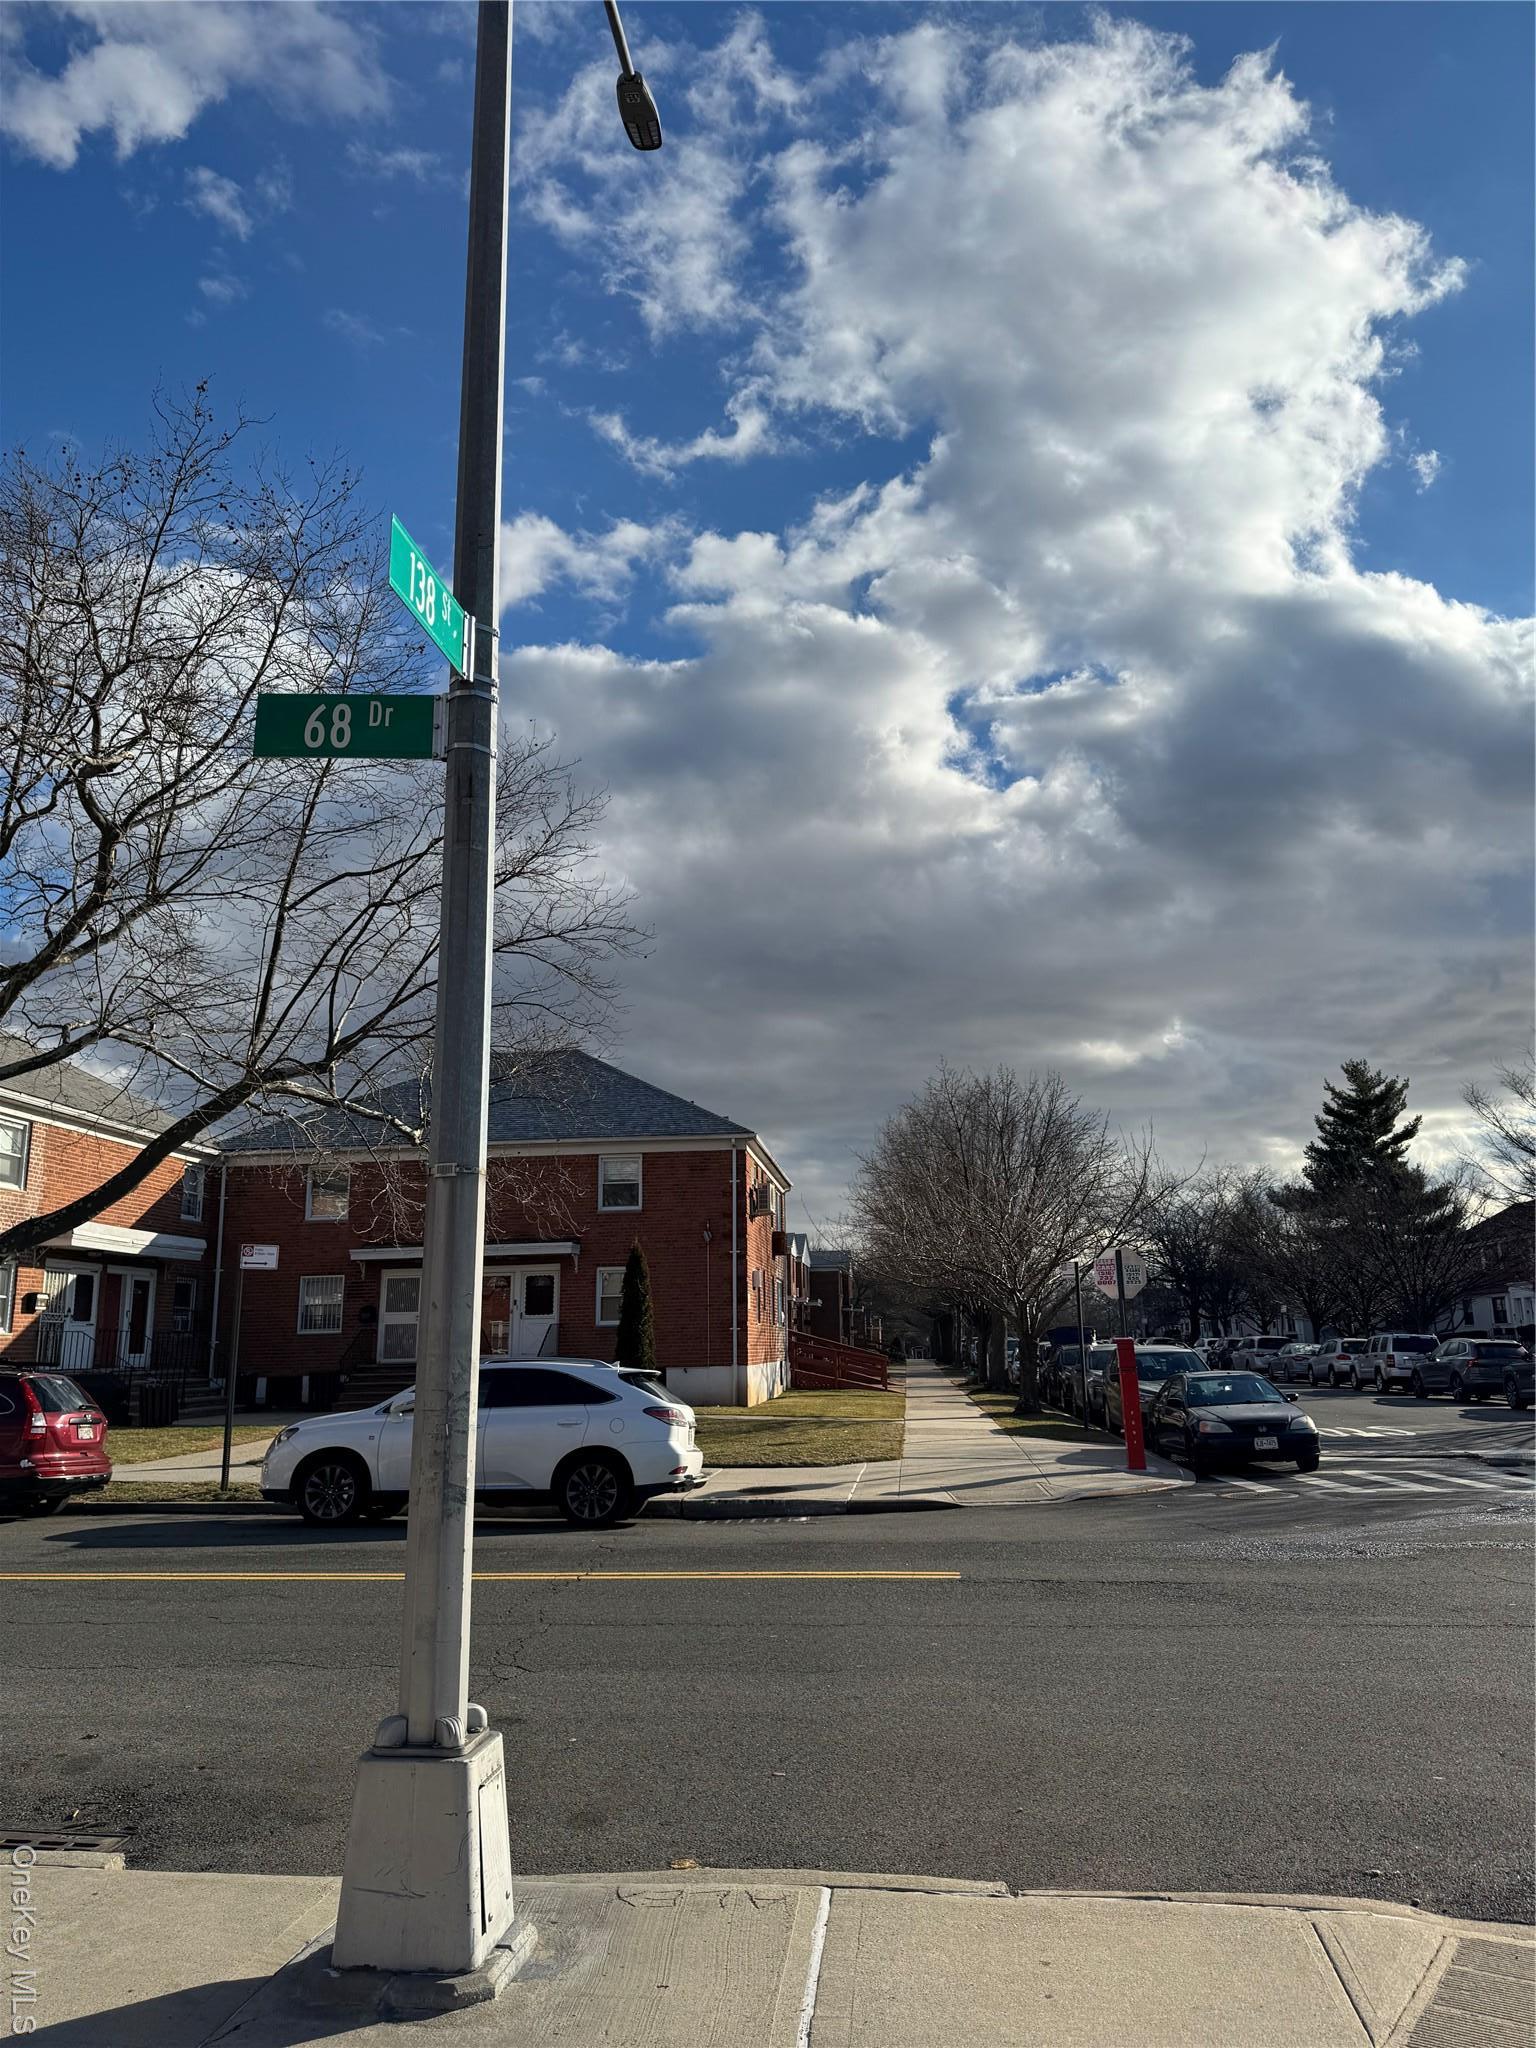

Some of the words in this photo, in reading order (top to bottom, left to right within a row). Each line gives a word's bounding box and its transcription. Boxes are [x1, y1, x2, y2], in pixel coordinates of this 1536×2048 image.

[410, 552, 435, 626] 138
[442, 592, 452, 627] St
[304, 703, 352, 749] 68
[369, 701, 394, 727] Dr
